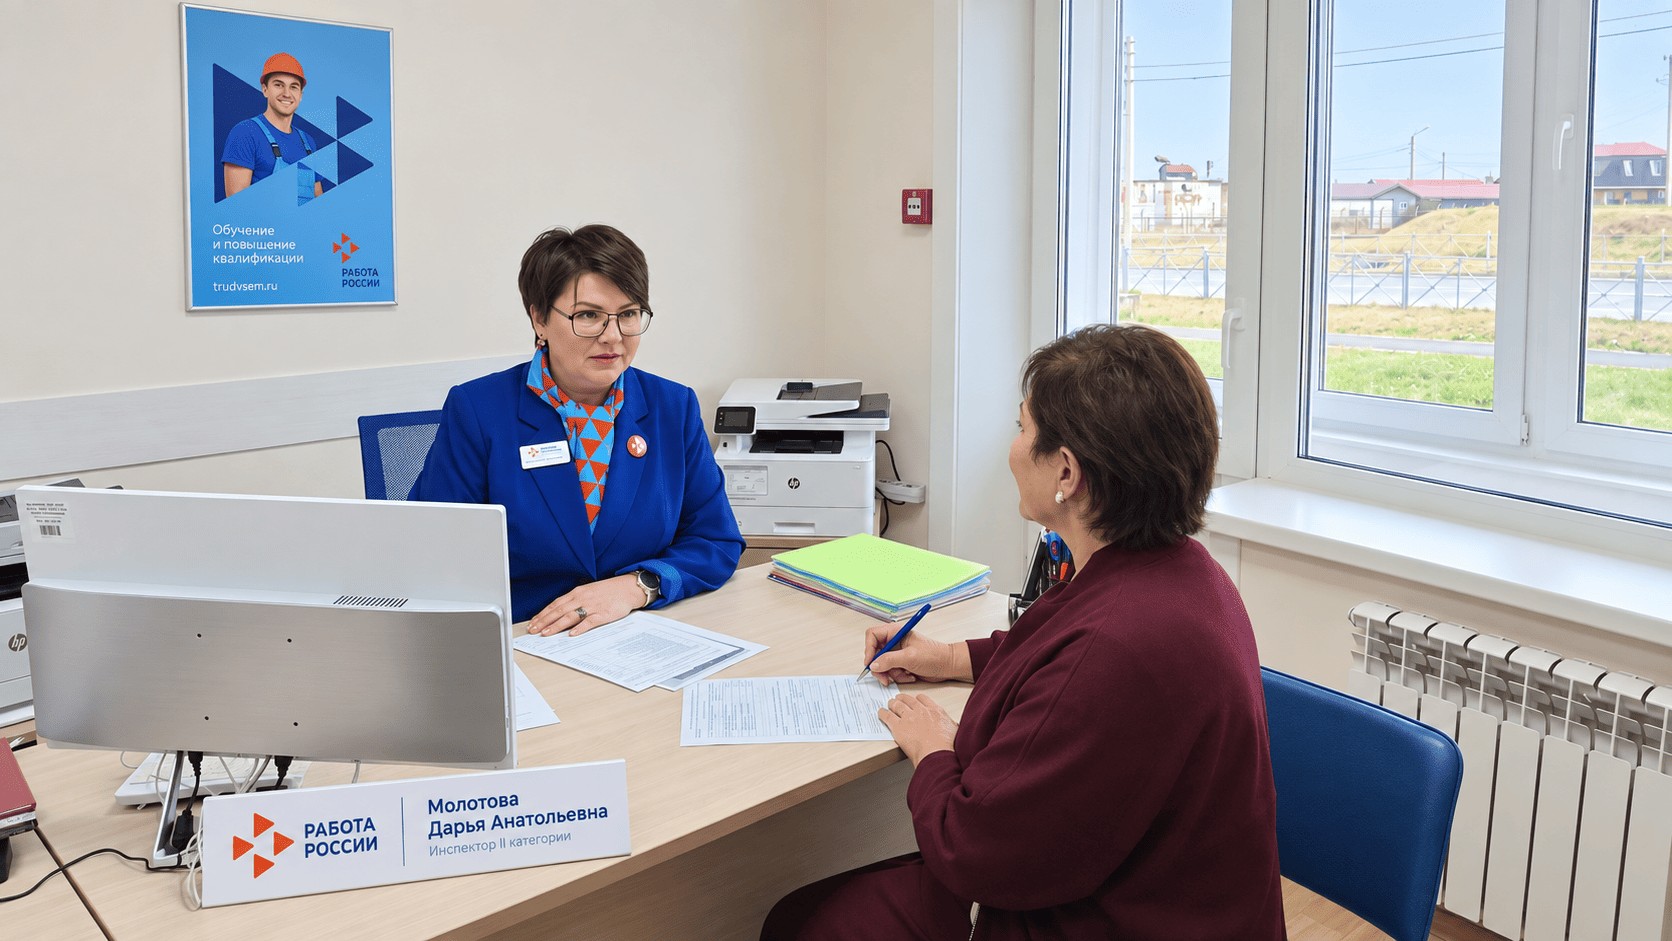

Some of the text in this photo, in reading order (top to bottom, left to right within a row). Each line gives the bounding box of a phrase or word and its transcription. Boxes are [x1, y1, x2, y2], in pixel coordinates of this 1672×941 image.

[212, 224, 275, 237] Обучение
[213, 240, 296, 250] и повышение
[213, 253, 304, 266] квалификации
[341, 268, 379, 277] РАБОТА
[213, 281, 278, 292] trudvsem.ru
[341, 279, 380, 288] РОССИИ
[788, 477, 800, 489] hp
[9, 633, 28, 652] hp
[428, 793, 519, 815] Молотова
[304, 817, 376, 839] РАБОТА
[428, 805, 608, 840] Дарья Анатольевна
[304, 836, 378, 859] РОССИИ
[429, 840, 497, 857] Инспектор
[509, 831, 572, 850] категории
